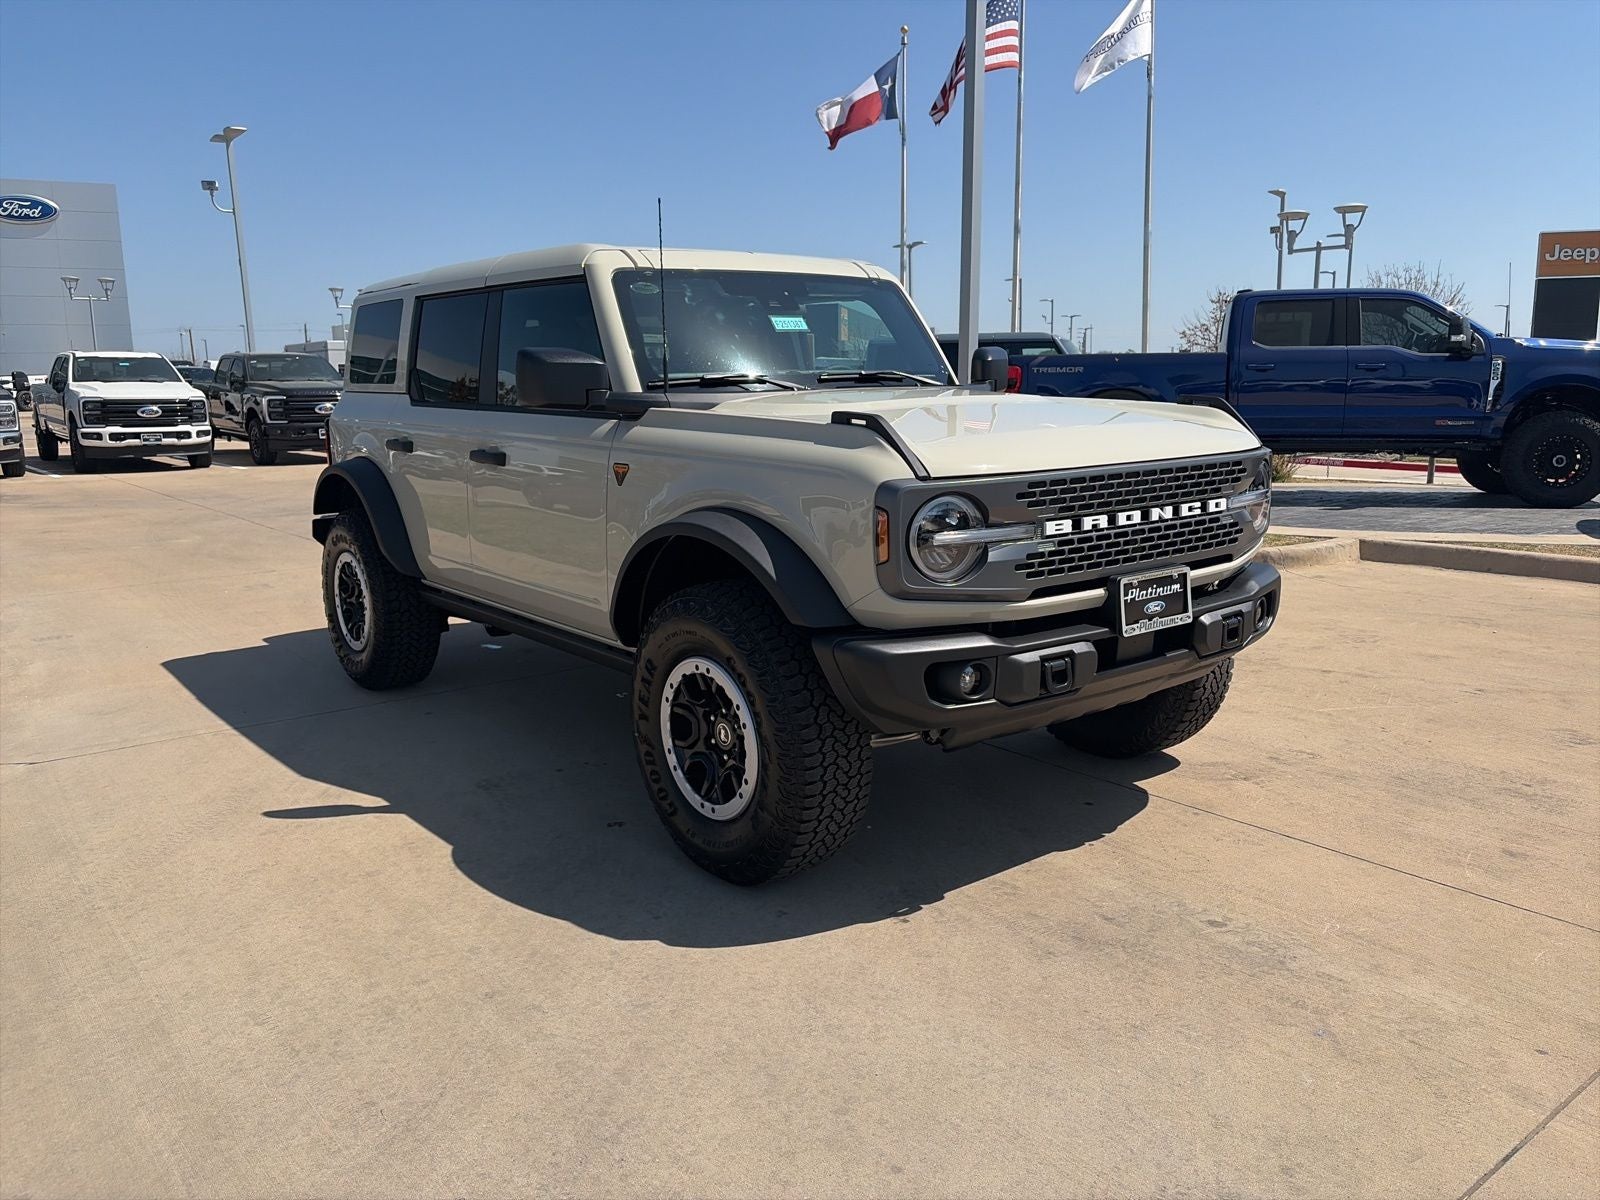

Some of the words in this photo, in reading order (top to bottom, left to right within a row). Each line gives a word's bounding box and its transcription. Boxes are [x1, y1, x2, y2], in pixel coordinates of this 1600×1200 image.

[0, 200, 42, 217] Ford
[1544, 244, 1600, 264] Jeep
[1044, 498, 1227, 535] BRONCO
[1124, 584, 1183, 602] Platinum
[1139, 617, 1178, 632] Platinum
